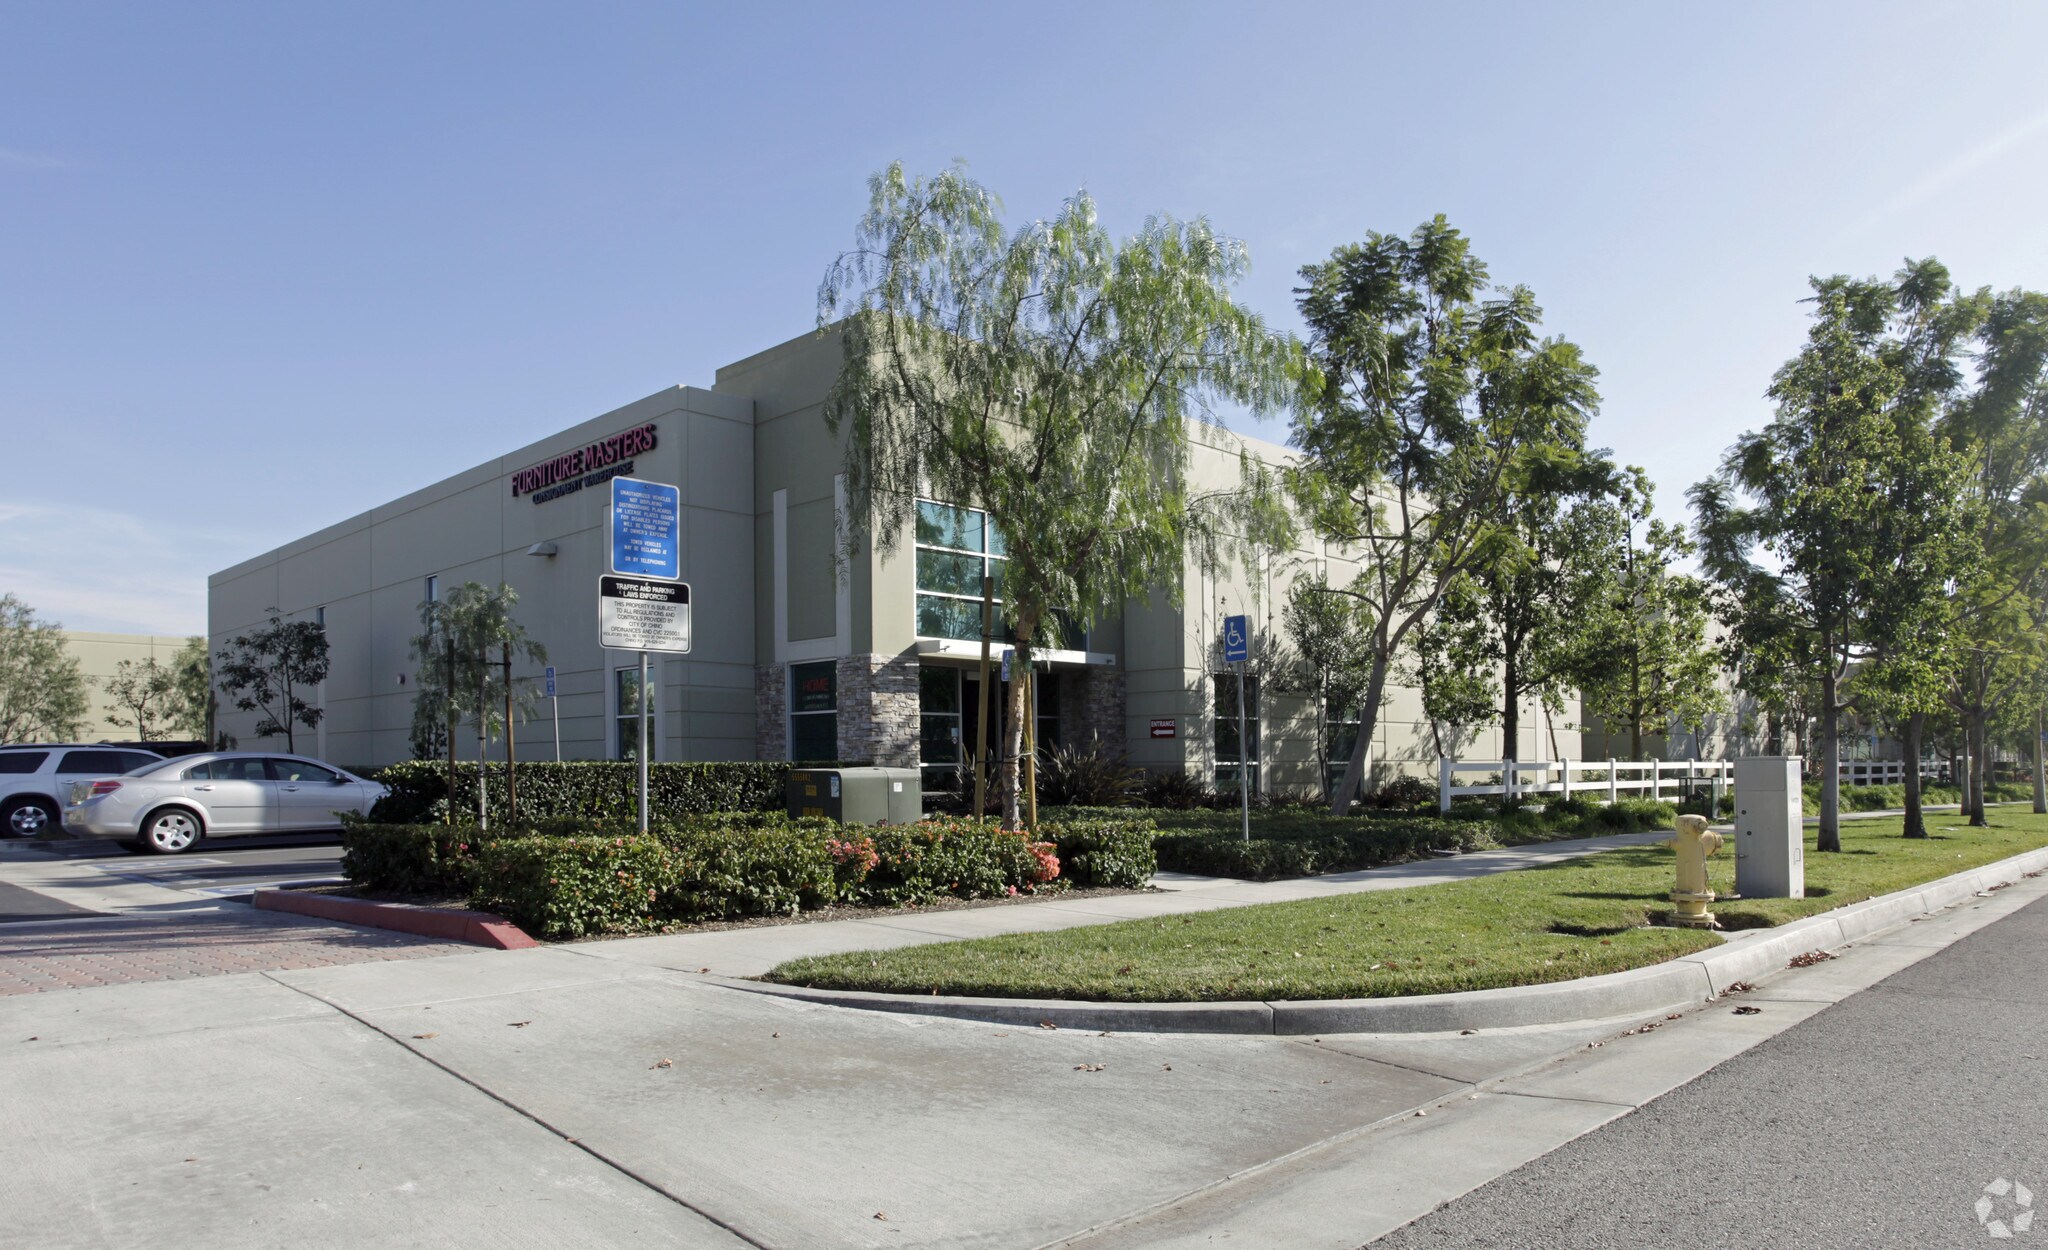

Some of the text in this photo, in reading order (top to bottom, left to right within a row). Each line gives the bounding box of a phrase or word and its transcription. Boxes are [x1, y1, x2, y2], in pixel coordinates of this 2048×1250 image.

[512, 424, 657, 496] FURNITURE MASTERS
[584, 461, 634, 487] WAREHOUSE
[620, 490, 671, 502] UNAUTHORIZED VEHICLES
[619, 502, 649, 511] DISTINGUISHING
[616, 583, 638, 591] TRAFFIC
